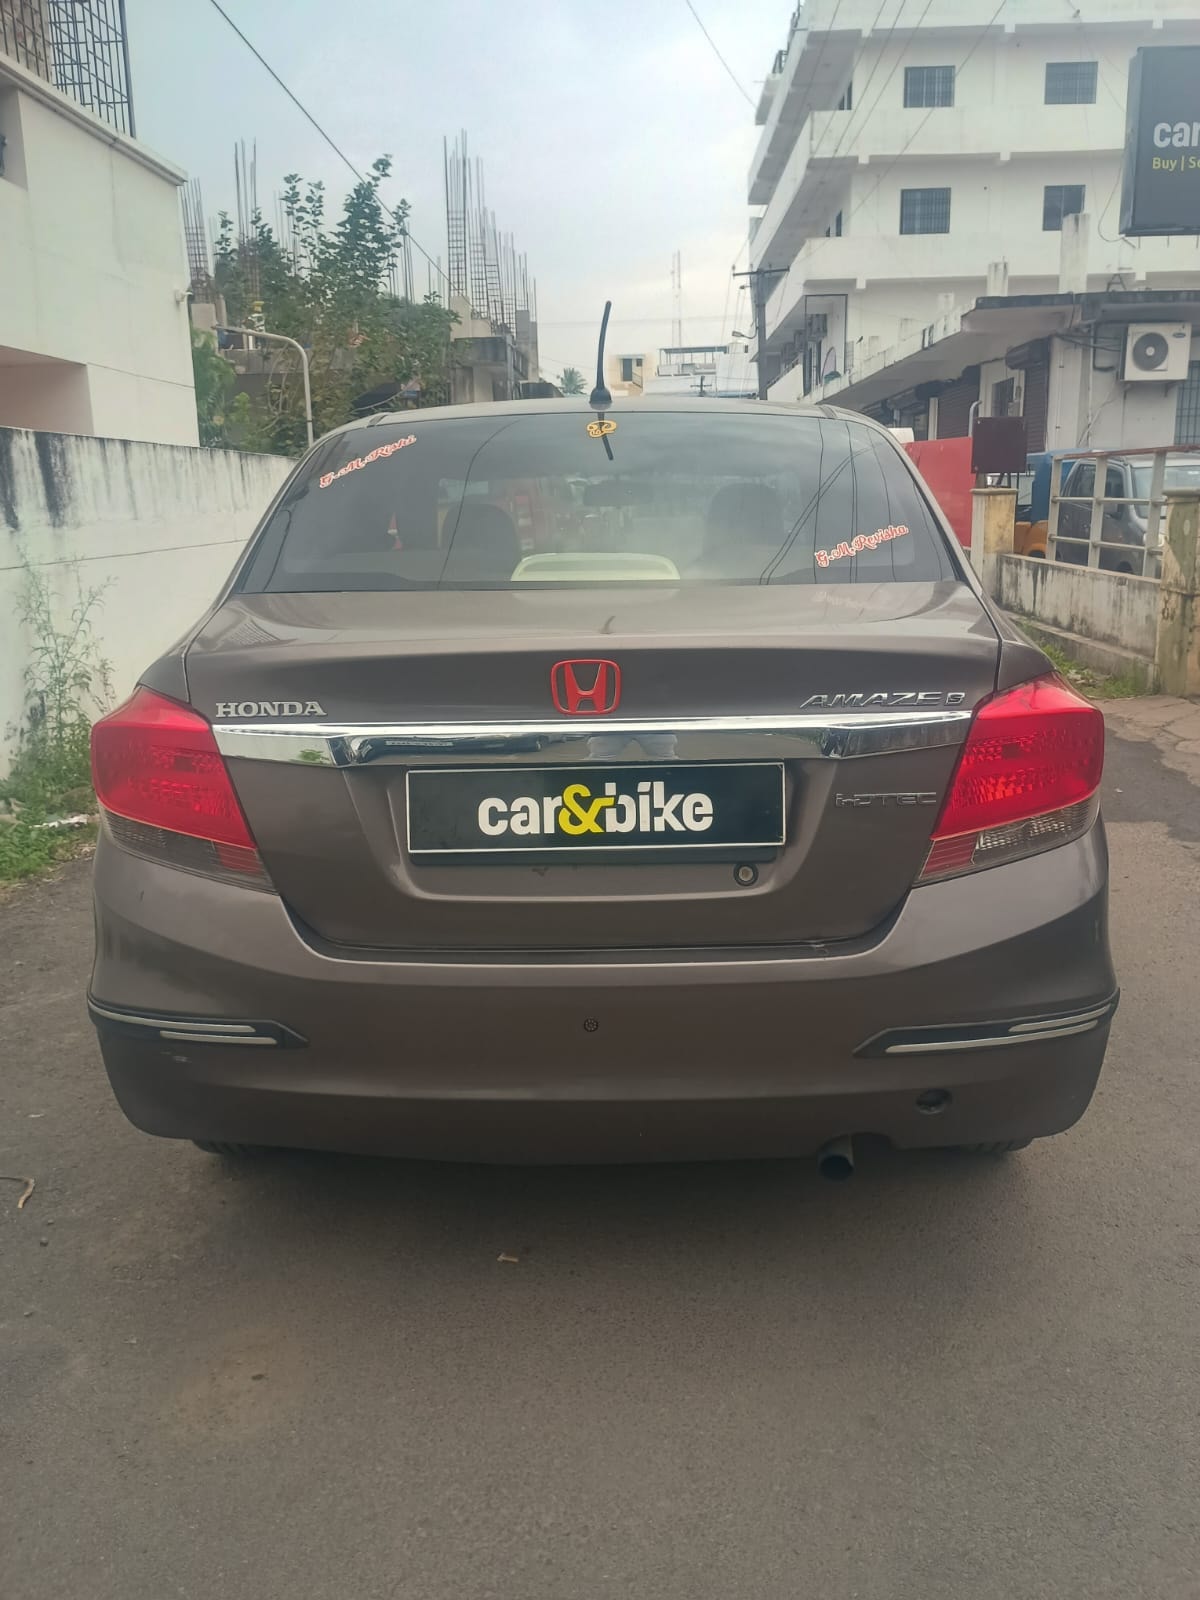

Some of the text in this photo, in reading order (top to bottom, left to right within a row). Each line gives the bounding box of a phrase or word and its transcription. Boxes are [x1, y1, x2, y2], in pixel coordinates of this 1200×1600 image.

[1152, 156, 1177, 172] Buy
[799, 692, 942, 709] AMAZE
[215, 701, 328, 718] HONDA
[477, 781, 714, 836] car&bike
